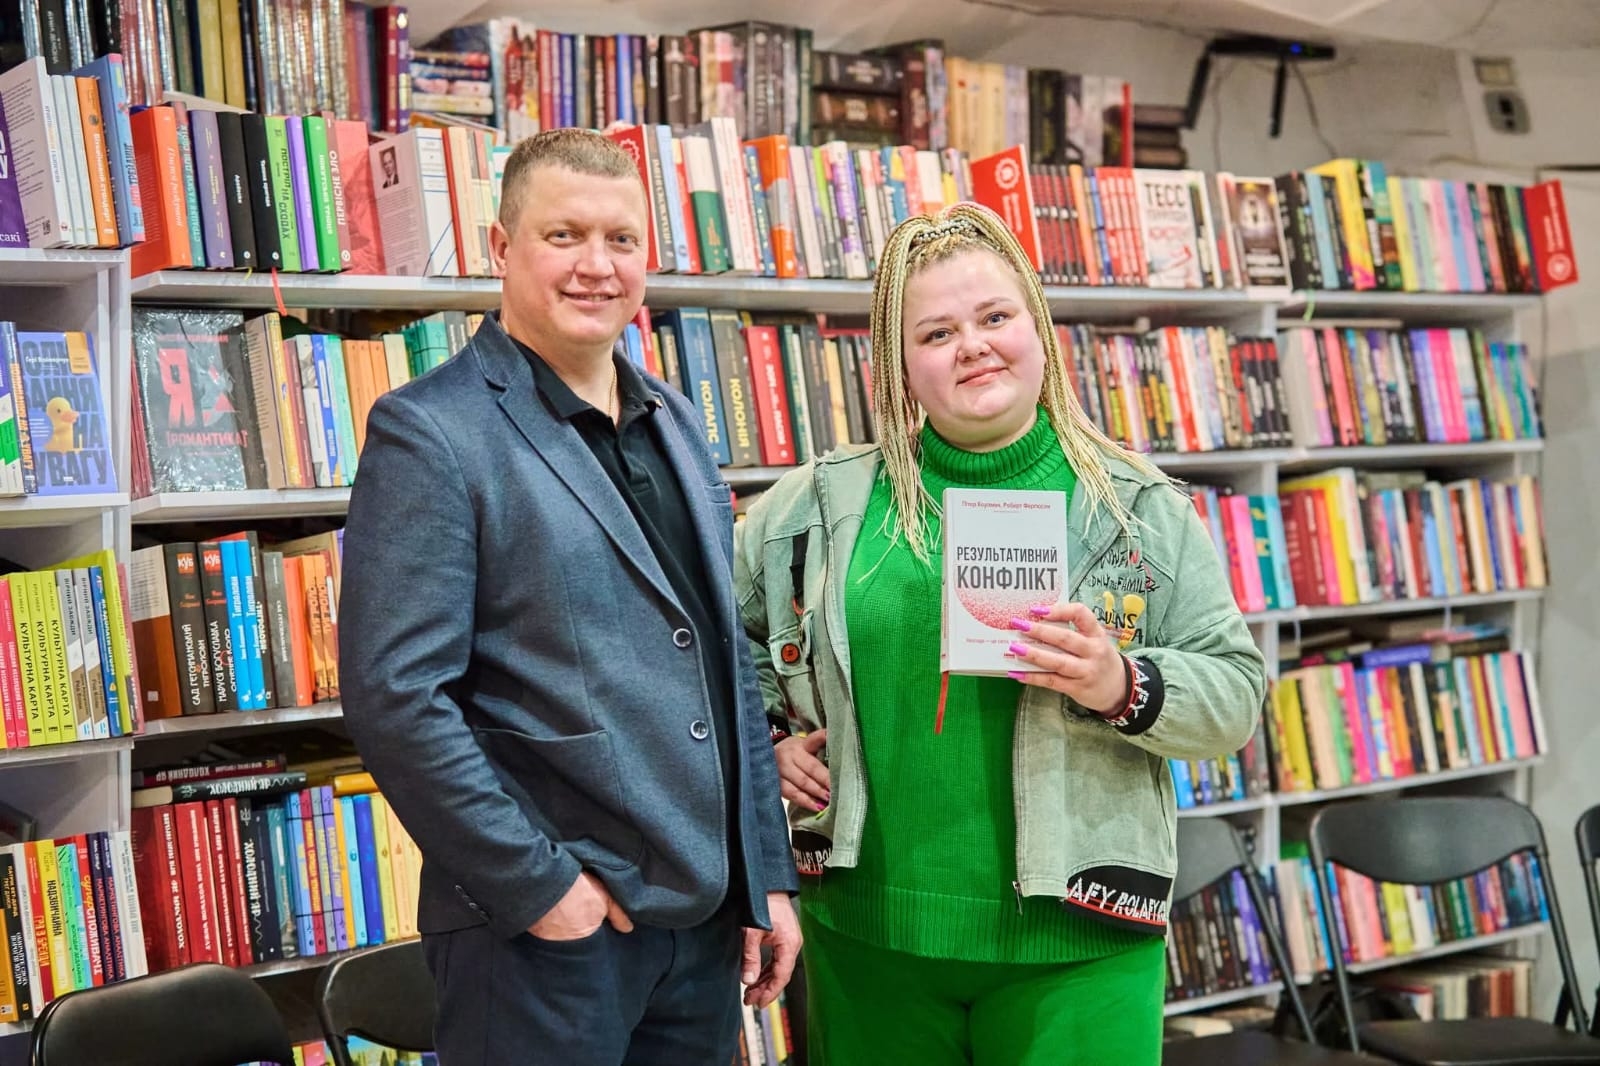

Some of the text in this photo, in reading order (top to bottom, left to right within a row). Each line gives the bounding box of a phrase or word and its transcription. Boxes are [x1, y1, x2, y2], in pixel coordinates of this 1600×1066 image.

[278, 147, 292, 240] ПОСТРІЛ НА СХОДАХ
[329, 150, 346, 225] ПЕРВІСНЕ ЗЛО
[158, 348, 195, 428] Я
[699, 380, 720, 444] КОЛАПС
[730, 378, 750, 448] КОЛОНІЯ
[177, 556, 194, 570] КУБ
[204, 554, 220, 568] КУБ
[956, 546, 1058, 563] РЕЗУЛЬТАТИВНИЙ
[956, 565, 1058, 591] КОНФЛІКТ
[67, 605, 76, 636] ЗАВЖДИ
[230, 576, 242, 618] Тигролови
[244, 576, 256, 617] Тигролови
[224, 628, 232, 655] КОЛО
[256, 603, 266, 652] ТИГРОЛОВИ
[20, 622, 34, 683] КУЛЬТУРНА
[27, 686, 39, 720] КАРТА
[36, 621, 50, 682] КУЛЬТУРНА
[44, 684, 56, 718] КАРТА
[51, 620, 66, 680] КУЛЬТУРНА
[59, 682, 71, 716] КАРТА
[182, 624, 200, 706] САД ГЕТСИМАНСЬКИЙ
[198, 639, 210, 688] ТИГРОЛОВИ
[209, 620, 227, 702] МАРУСЯ БОГУСЛАВКА
[156, 772, 167, 782] ЯР
[168, 766, 210, 780] ХОЛОДНИЙ
[209, 777, 258, 795] ХОЛОДНИЙ
[244, 842, 261, 900] ХОЛОДНИЙ
[34, 914, 44, 928] ГРА
[47, 880, 62, 936] НАДЗВИЧАЙНА
[80, 875, 104, 976] суперСПОЖИВАЧІ
[96, 878, 108, 936] МАРКЕТИНГОВА
[103, 936, 114, 980] АНАЛІТИКА
[108, 876, 120, 934] МАРКЕТИНГОВА
[114, 935, 124, 978] АНАЛІТИКА
[172, 896, 185, 949] ХОЛОДНИЙ
[16, 932, 25, 965] ОБИРАЙТЕ
[36, 934, 50, 967] БРЕНДИ
[12, 963, 22, 986] МУДРО
